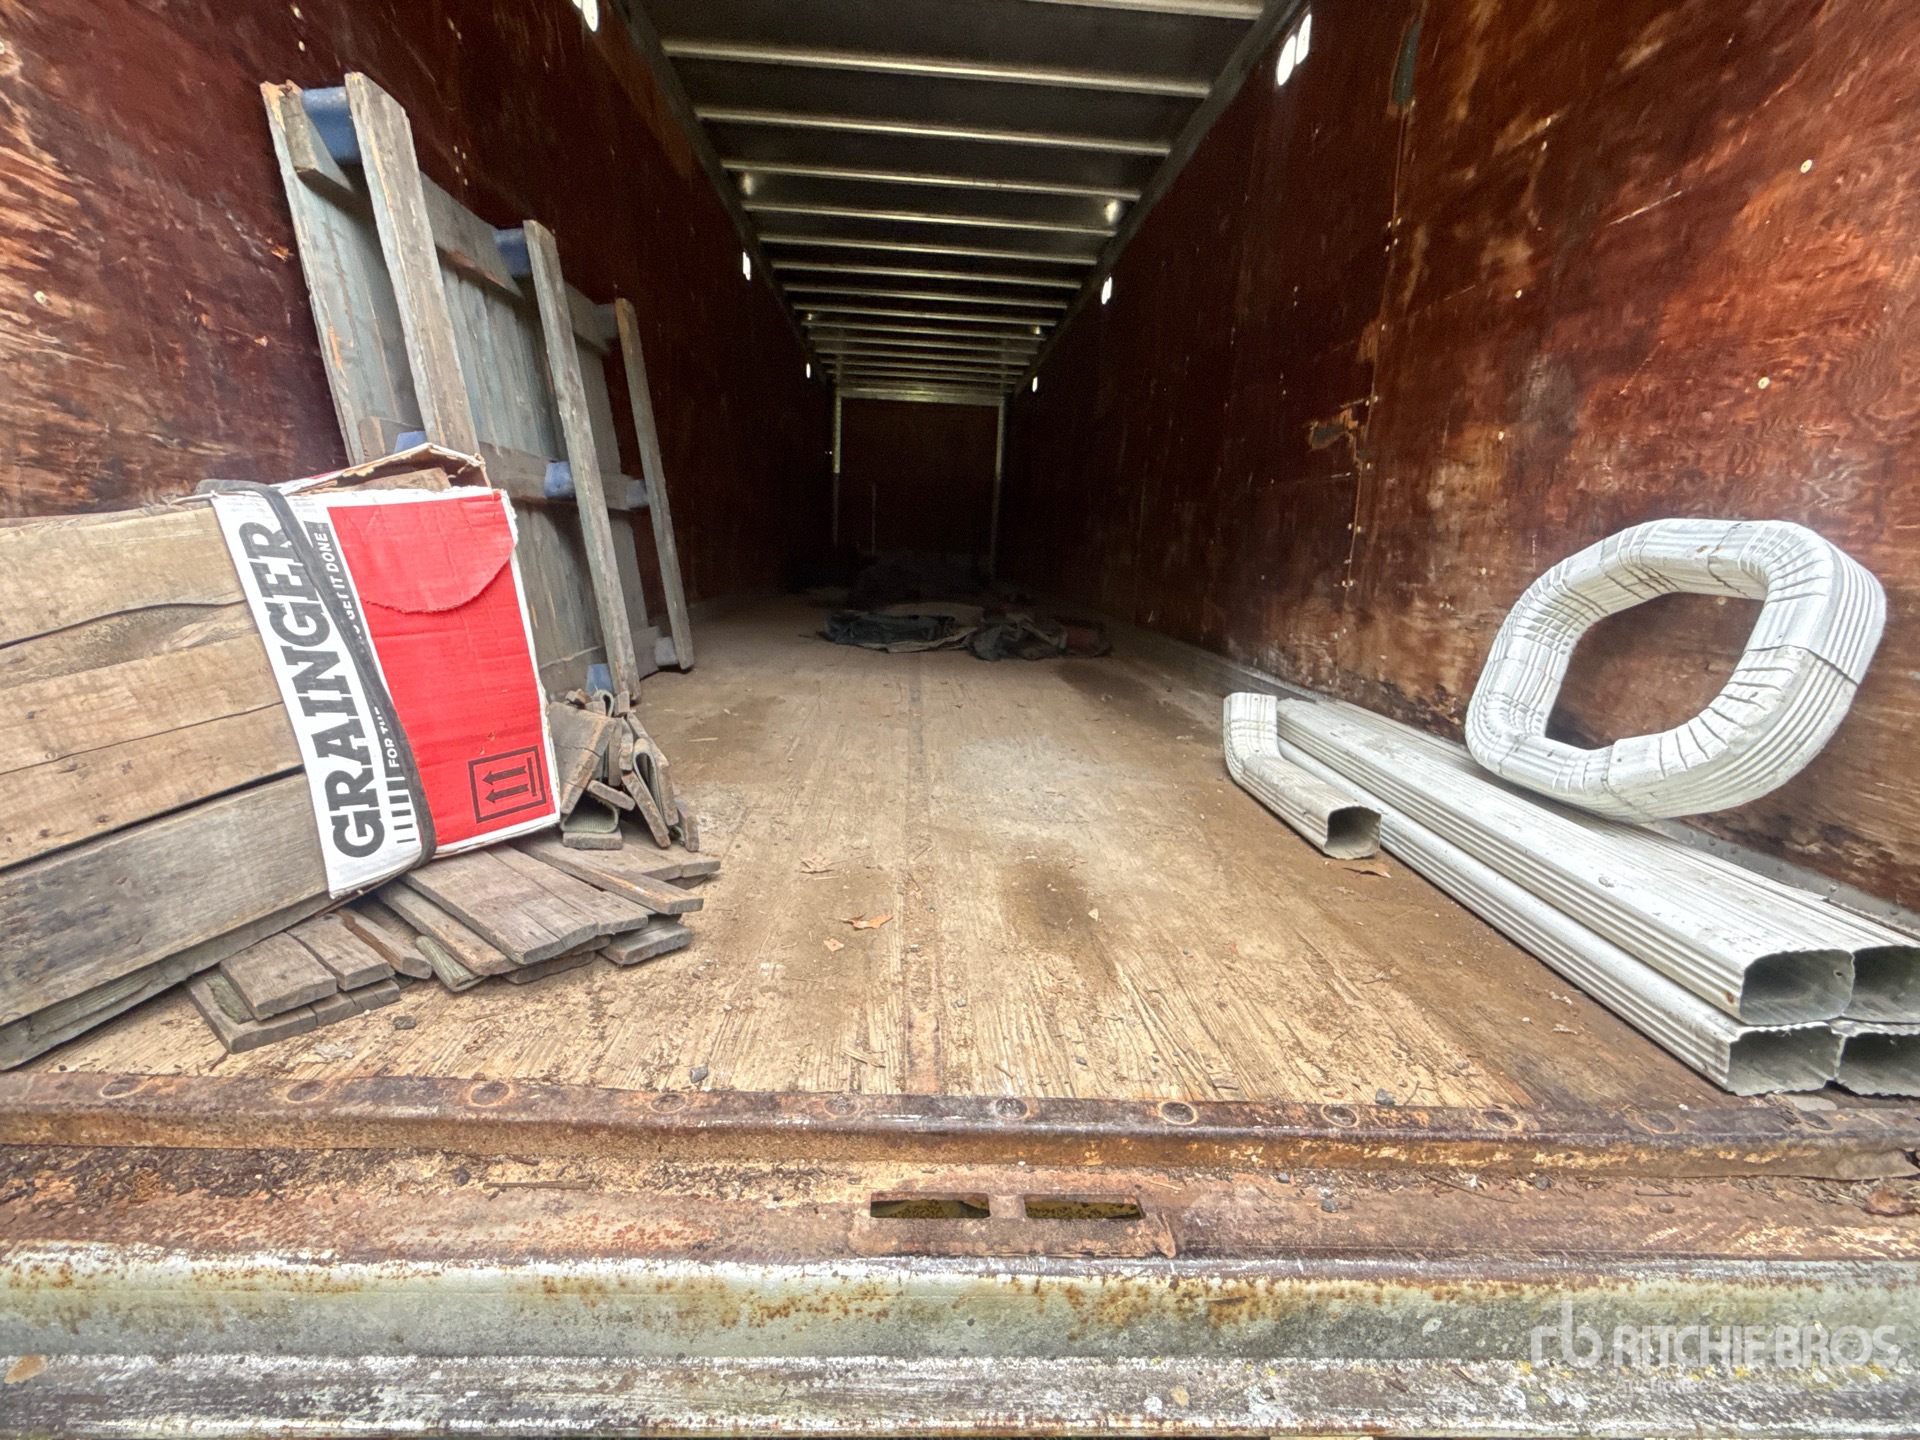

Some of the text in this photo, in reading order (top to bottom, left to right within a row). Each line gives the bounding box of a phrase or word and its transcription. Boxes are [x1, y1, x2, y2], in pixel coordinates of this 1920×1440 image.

[314, 532, 340, 573] DONE
[329, 575, 346, 589] IT
[239, 522, 385, 858] GRAINGER
[384, 738, 400, 768] FOR
